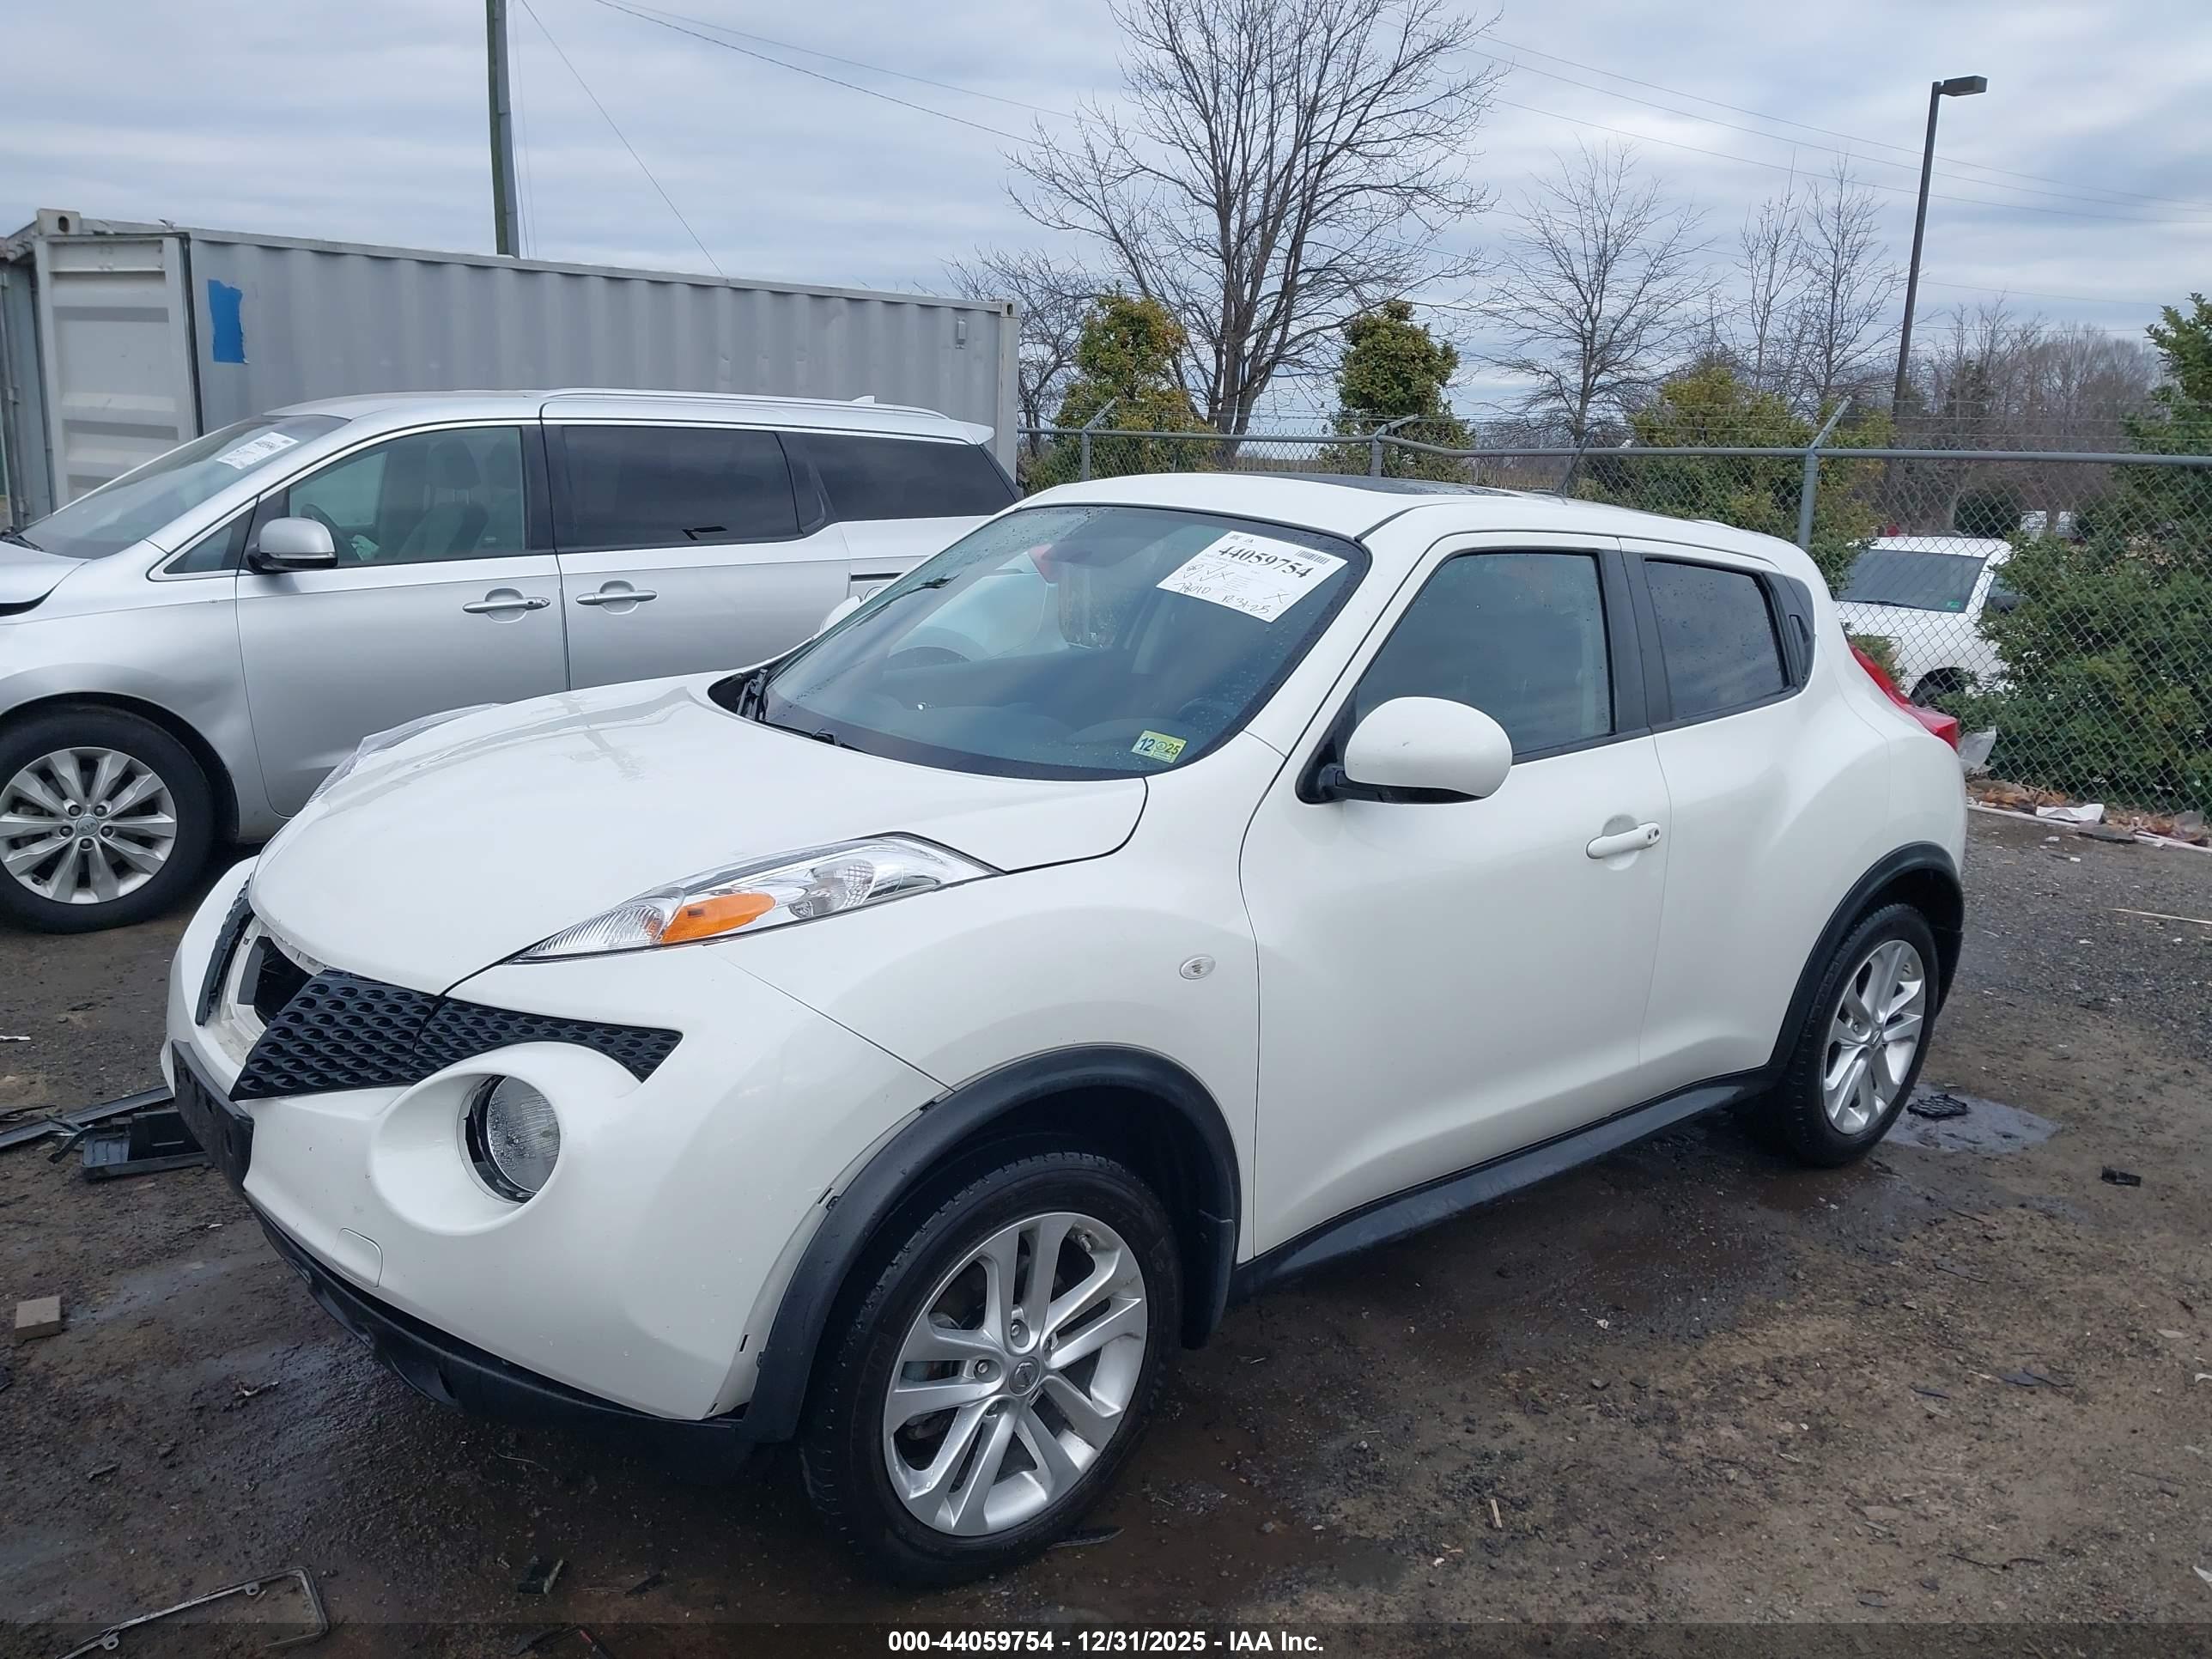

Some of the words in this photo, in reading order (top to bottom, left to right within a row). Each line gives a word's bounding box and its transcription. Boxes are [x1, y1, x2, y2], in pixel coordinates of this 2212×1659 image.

[1218, 545, 1315, 578] 44059754
[1139, 737, 1156, 752] 12
[1164, 743, 1181, 756] 25
